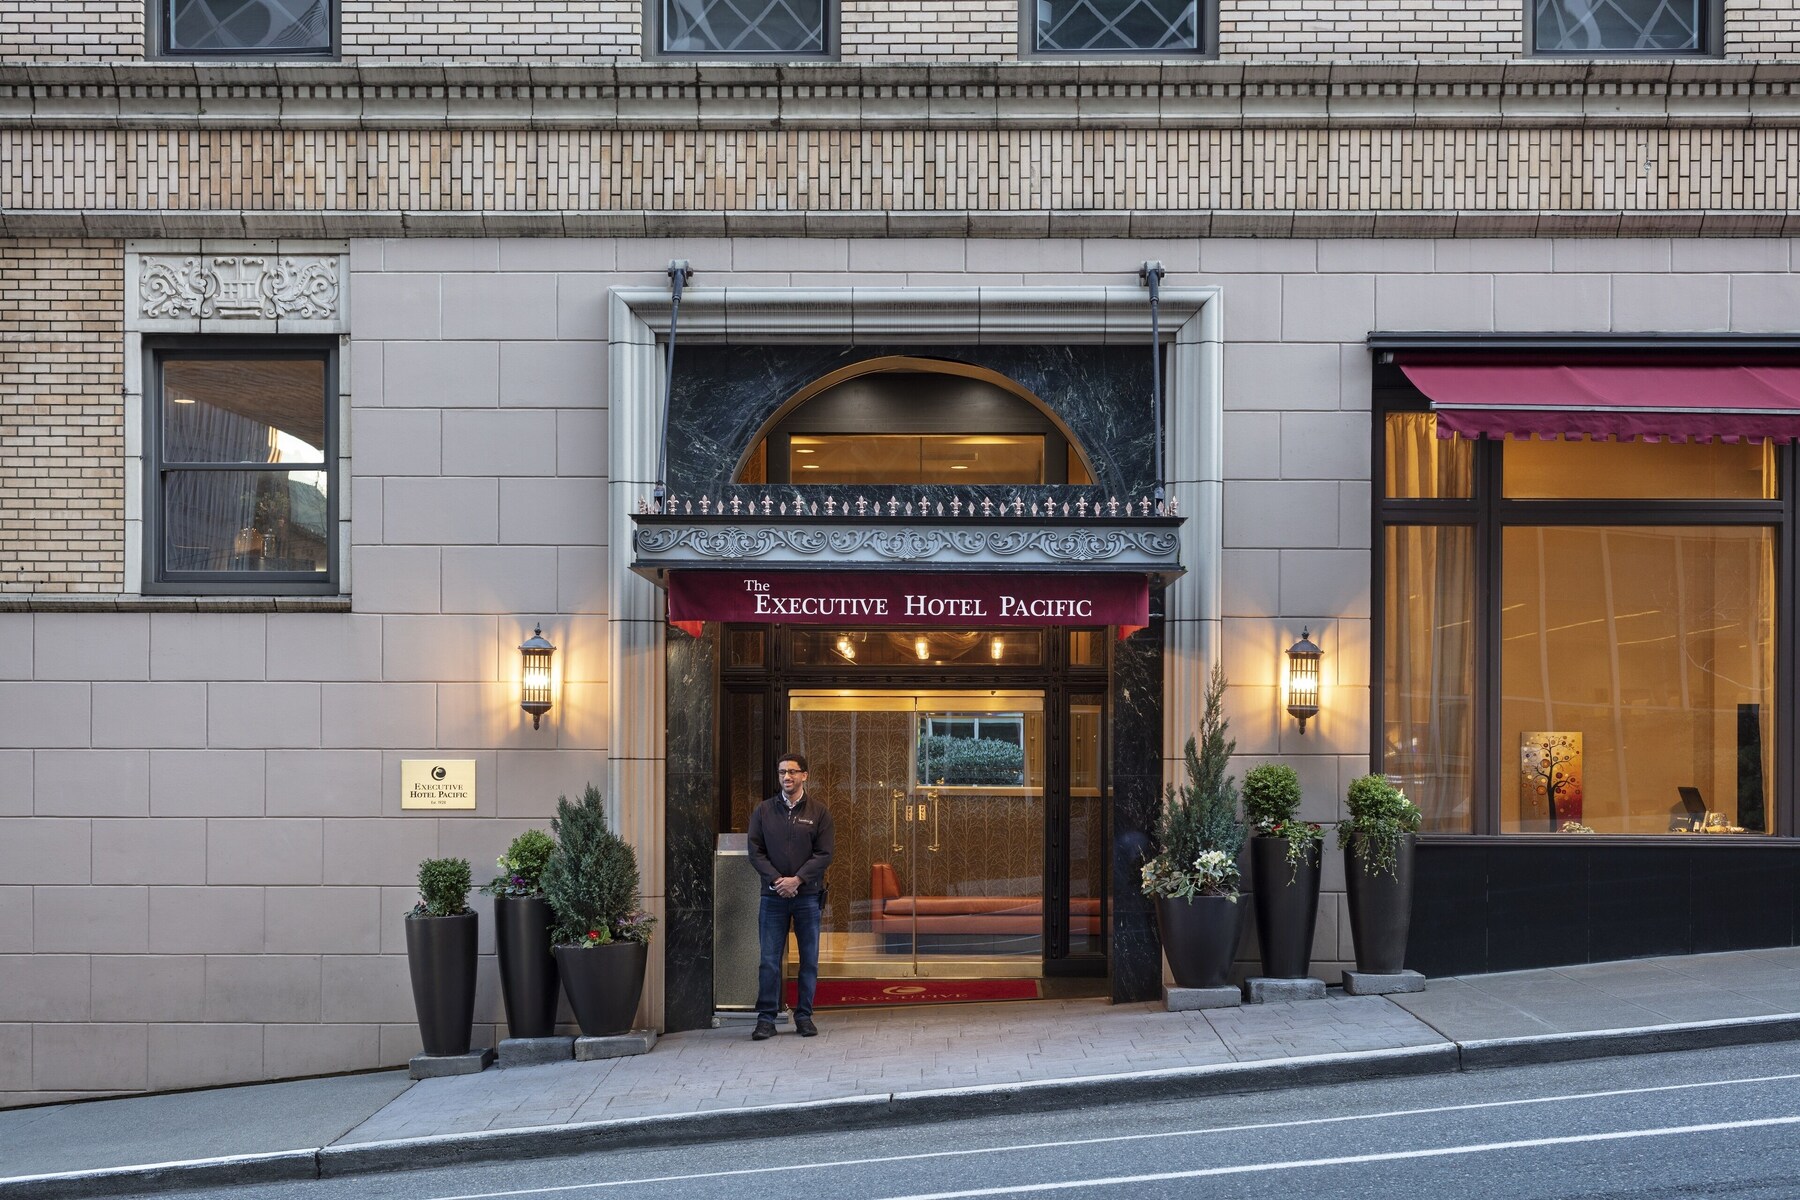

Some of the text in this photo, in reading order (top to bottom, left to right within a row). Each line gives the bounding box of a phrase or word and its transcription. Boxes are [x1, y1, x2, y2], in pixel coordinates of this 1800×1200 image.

[743, 579, 770, 592] The
[754, 594, 1093, 618] EXECUTIVE HOTEL PACIFIC
